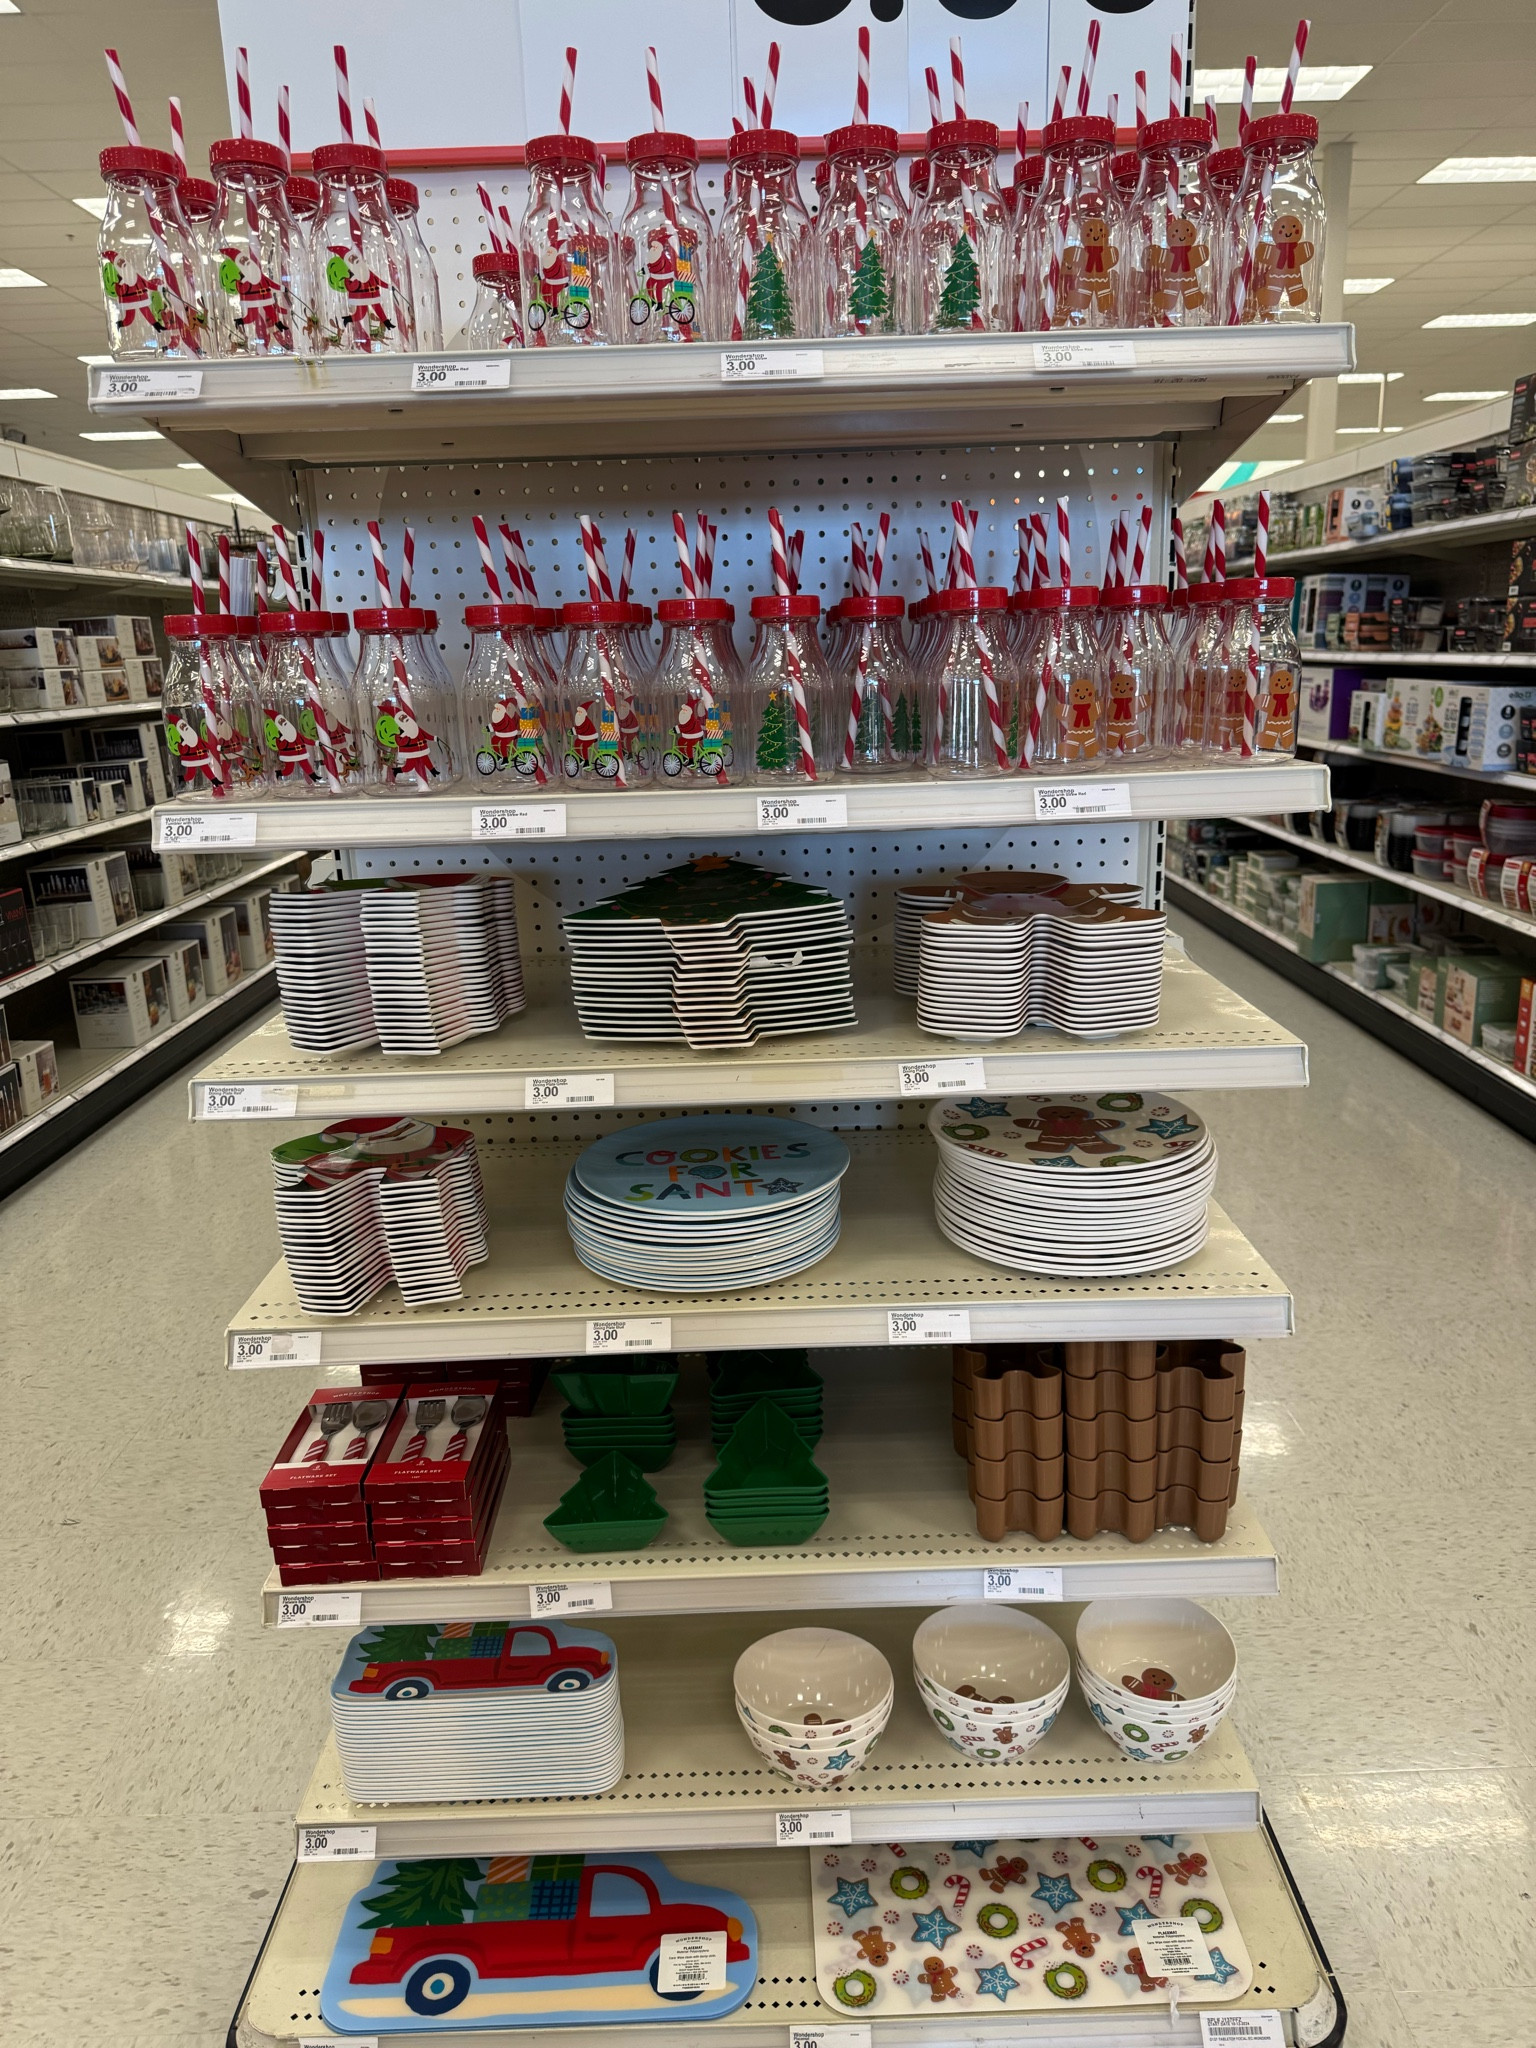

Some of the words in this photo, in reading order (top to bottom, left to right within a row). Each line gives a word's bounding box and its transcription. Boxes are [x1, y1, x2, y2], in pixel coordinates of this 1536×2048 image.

[1043, 352, 1072, 362] 3.00
[726, 361, 755, 371] 3.00
[417, 372, 446, 382] 3.00
[108, 382, 137, 393] 3.00
[1040, 797, 1066, 808] 3.00
[762, 807, 788, 818] 3.00
[480, 817, 507, 828] 3.00
[165, 825, 192, 837] 3.00
[904, 1072, 929, 1084] 3.00
[533, 1086, 558, 1097] 3.00
[209, 1095, 235, 1106] 3.00
[615, 1142, 811, 1166] COOKIES
[668, 1162, 758, 1182] FOR
[893, 1321, 916, 1331] 3.00
[594, 1330, 618, 1341] 3.00
[238, 1344, 262, 1356] 3.00
[988, 1575, 1011, 1586] 3.00
[537, 1592, 560, 1604] 3.00
[283, 1604, 306, 1615] 3.00
[780, 1822, 802, 1832] 3.00
[305, 1838, 327, 1848] 3.00
